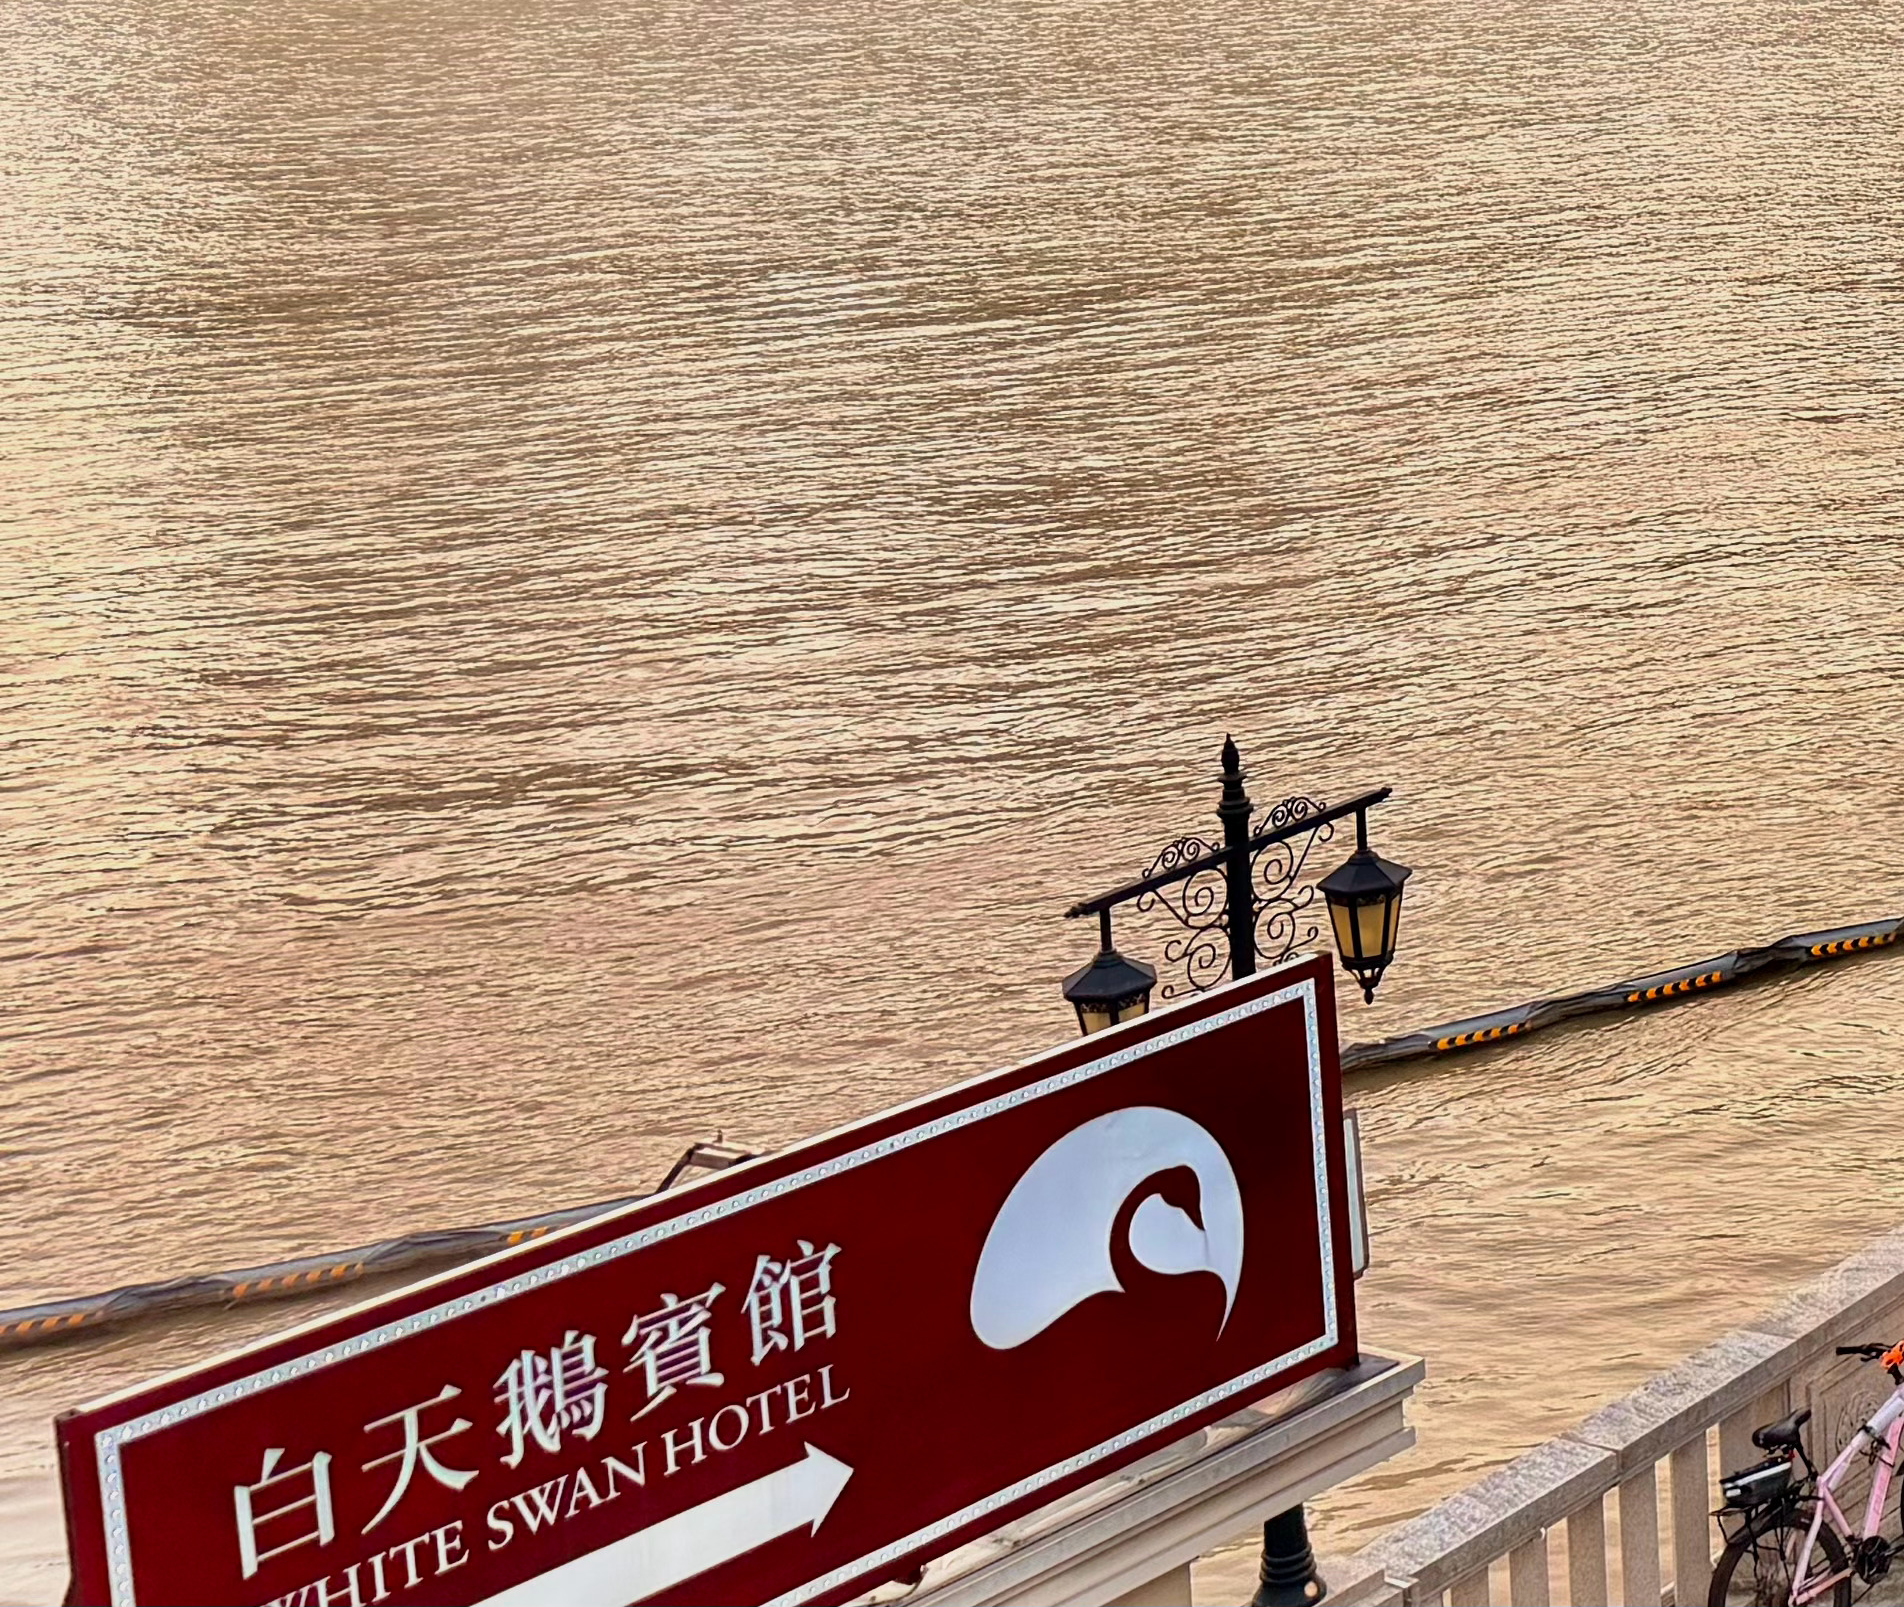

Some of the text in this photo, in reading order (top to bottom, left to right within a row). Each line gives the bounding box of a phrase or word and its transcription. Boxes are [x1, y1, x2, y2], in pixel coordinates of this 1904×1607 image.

[234, 1239, 841, 1580] 白天鵝賓館
[488, 1442, 645, 1551] SWAN
[661, 1364, 851, 1477] HOTEL
